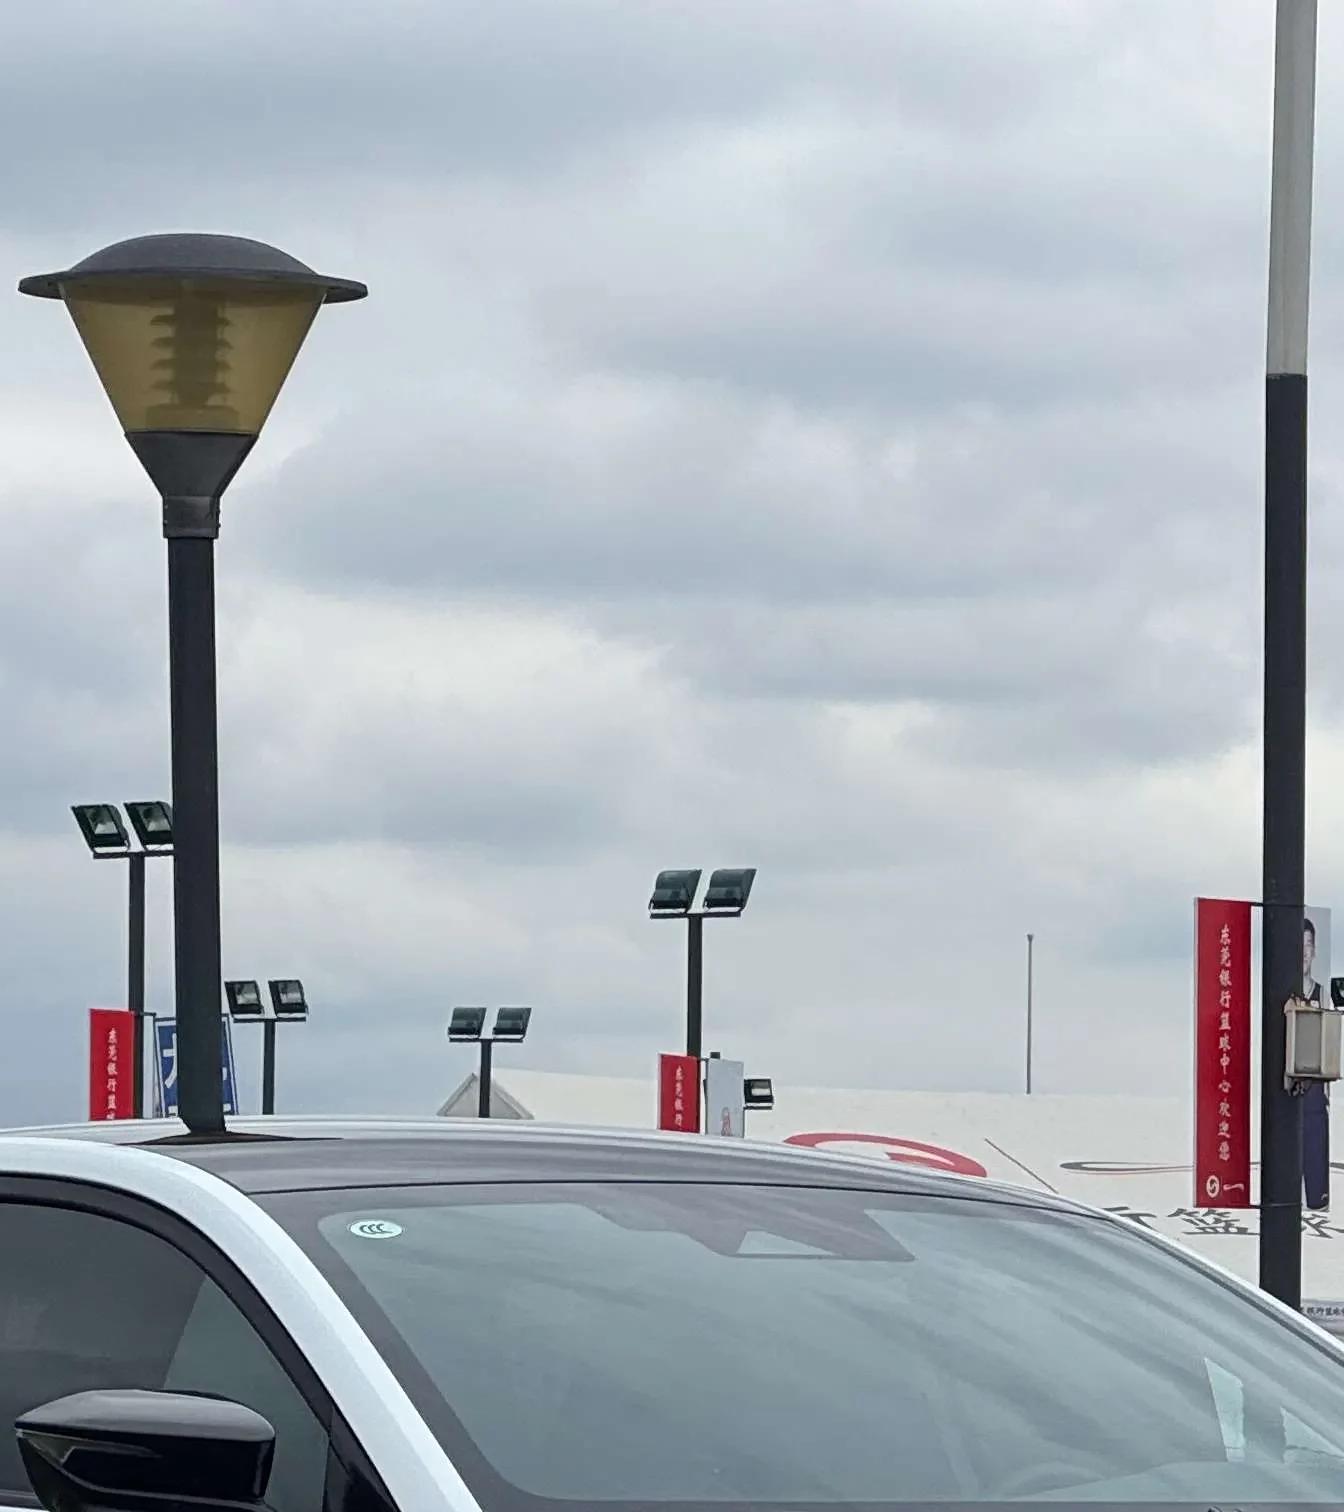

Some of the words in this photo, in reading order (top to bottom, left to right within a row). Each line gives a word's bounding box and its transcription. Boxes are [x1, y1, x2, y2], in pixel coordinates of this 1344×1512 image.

[1217, 924, 1232, 1161] 东莞银行篮球中心欢迎您
